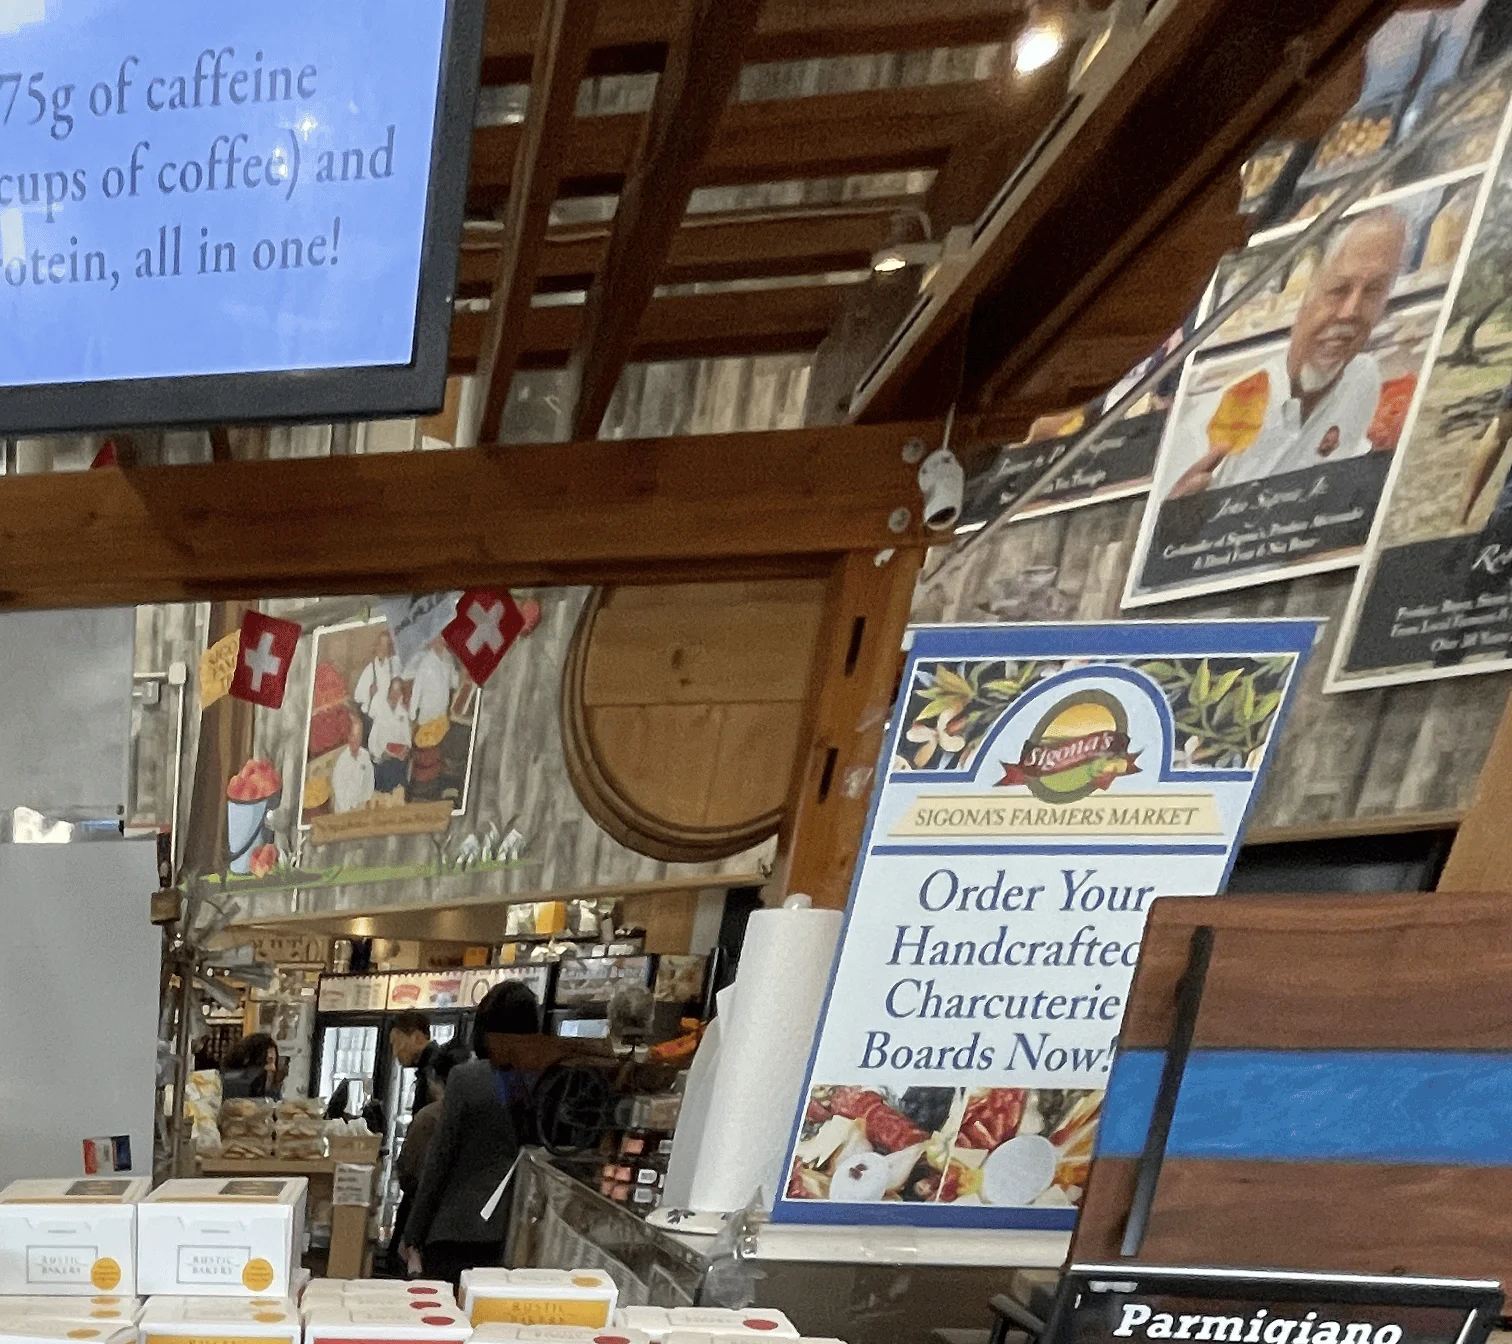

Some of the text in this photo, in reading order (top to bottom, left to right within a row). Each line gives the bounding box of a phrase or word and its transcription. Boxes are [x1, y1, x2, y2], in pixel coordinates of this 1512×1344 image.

[90, 56, 140, 117] of
[146, 46, 318, 112] caffeine
[103, 139, 150, 200] of
[157, 127, 302, 200] coffee)
[315, 125, 395, 182] and
[135, 225, 184, 280] all
[197, 226, 237, 274] in
[252, 215, 341, 270] one!
[1023, 733, 1116, 770] Sigona's
[915, 806, 1199, 828] SIGONA'S FARMERS MARKET
[919, 868, 1155, 913] Order Your
[886, 978, 1121, 1021] Charcuterie
[858, 1030, 1120, 1074] Boards Now!
